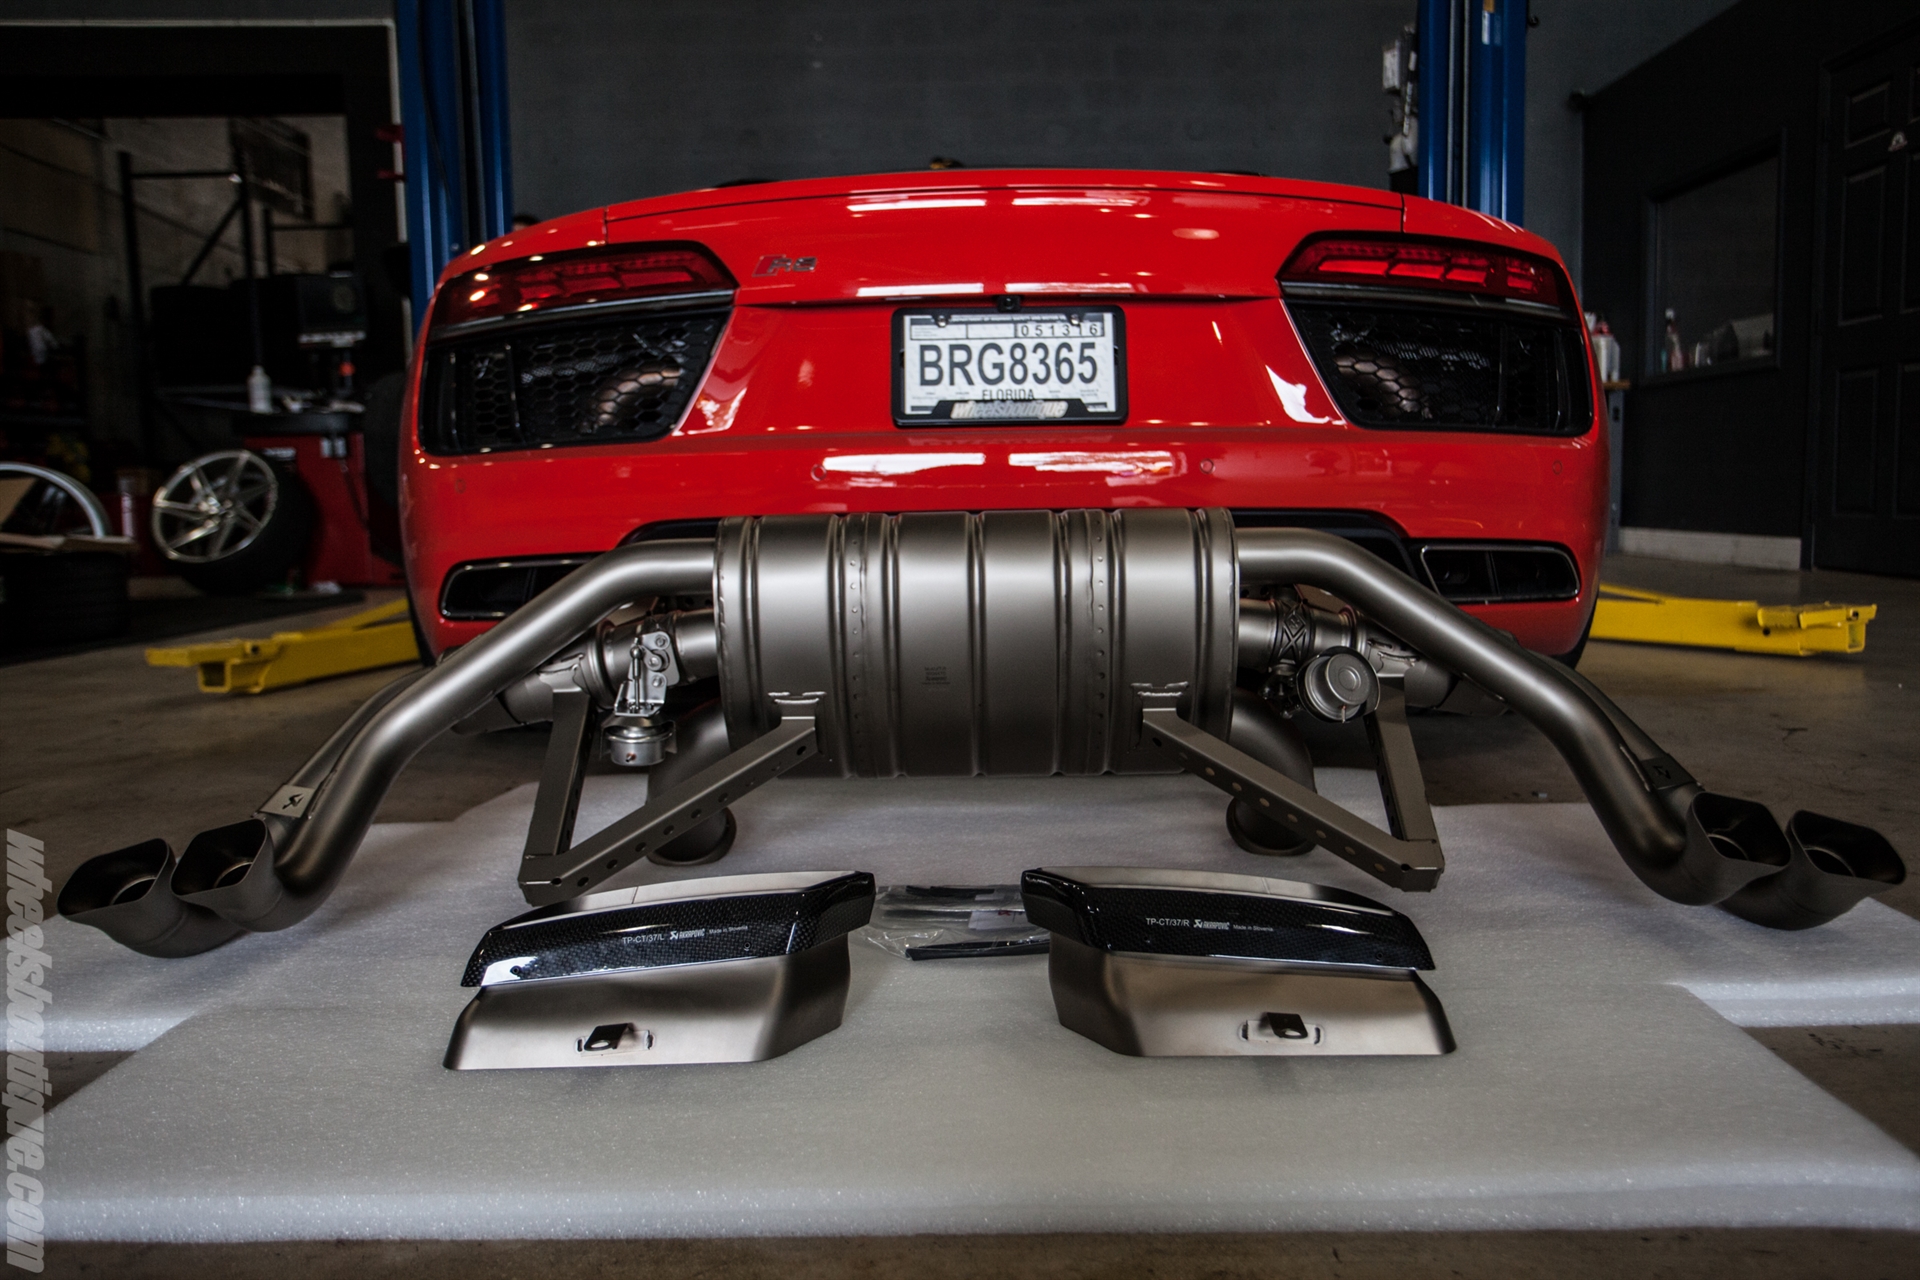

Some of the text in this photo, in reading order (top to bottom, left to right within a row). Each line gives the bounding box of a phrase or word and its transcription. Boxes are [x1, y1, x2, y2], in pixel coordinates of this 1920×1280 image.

[1021, 323, 1098, 337] 051316
[919, 342, 1098, 387] BRG8365
[982, 388, 1035, 400] FLORIDA
[951, 400, 1068, 419] wheelsboutique
[1146, 917, 1190, 927] TP-CT/37/R
[622, 934, 665, 945] TP-CT/37/L
